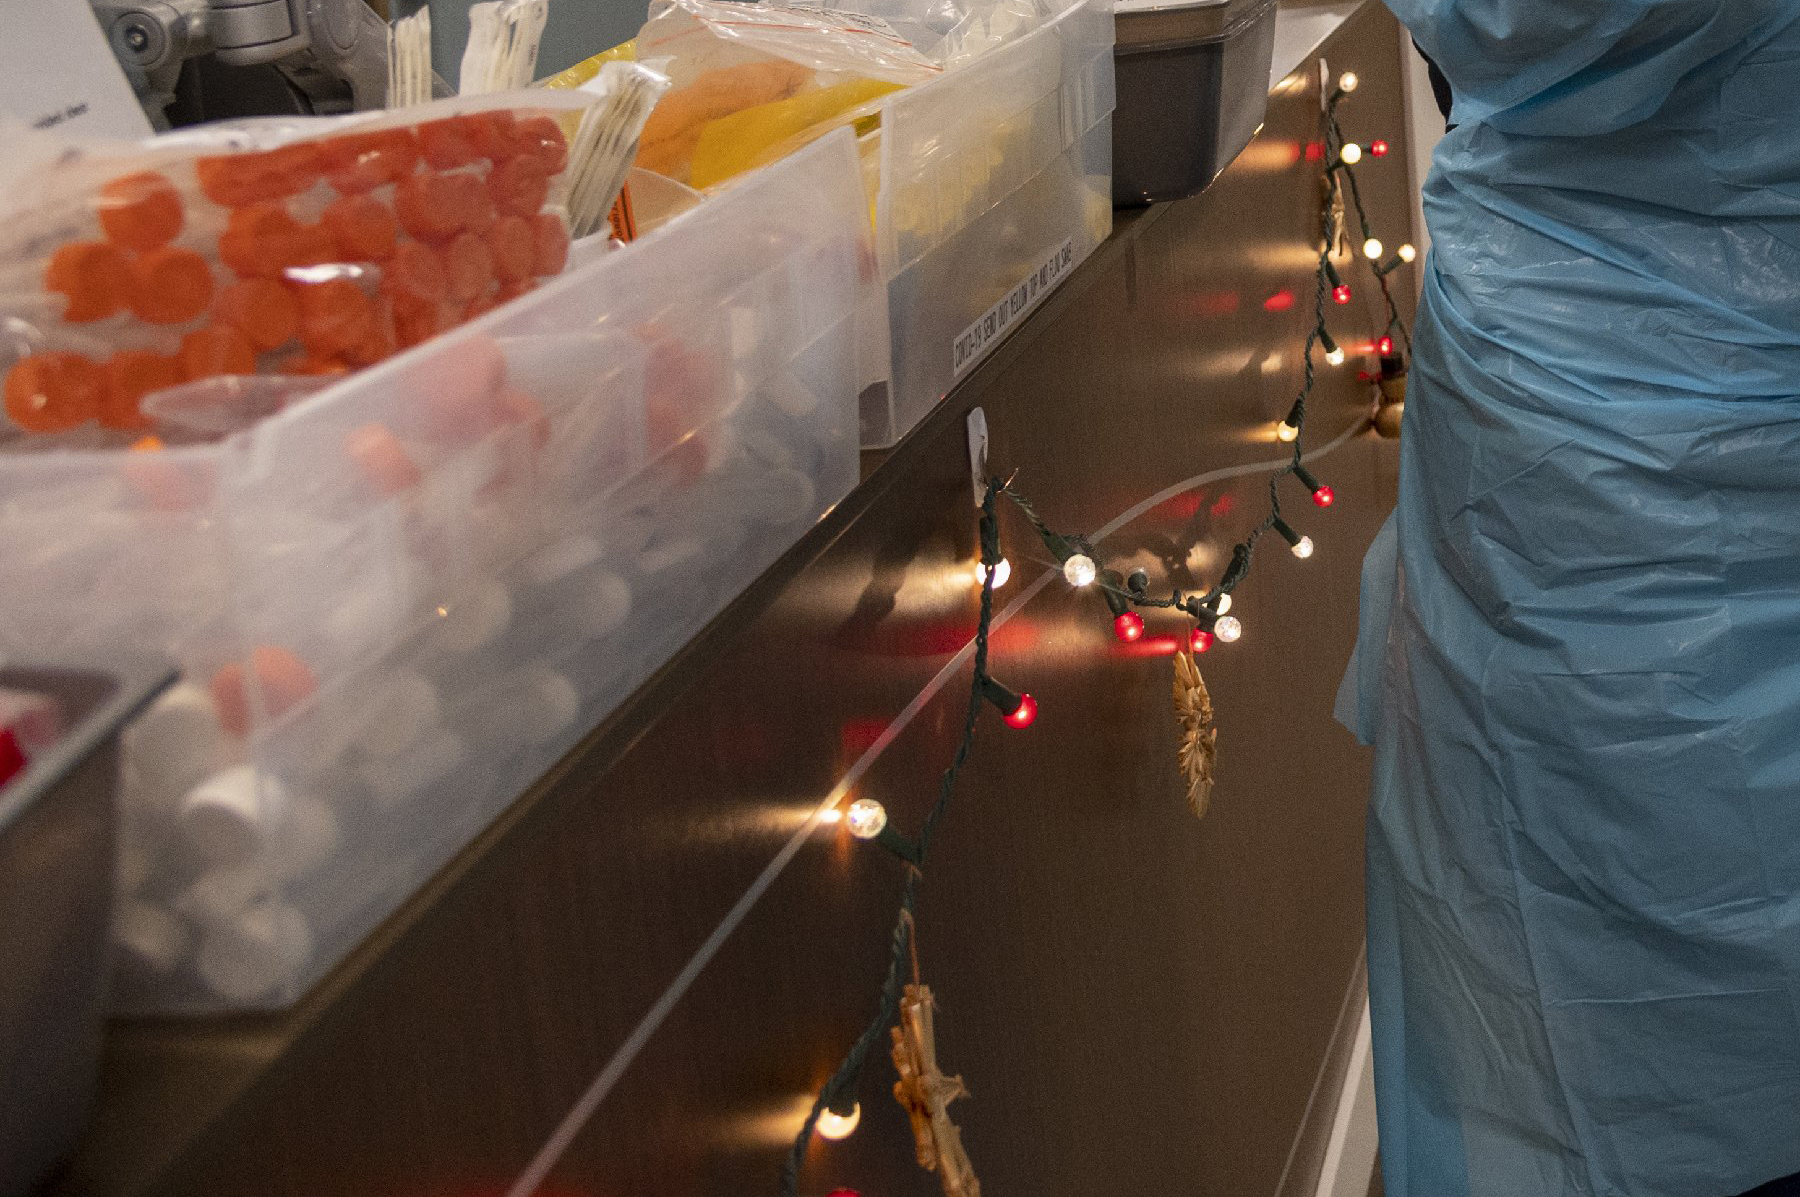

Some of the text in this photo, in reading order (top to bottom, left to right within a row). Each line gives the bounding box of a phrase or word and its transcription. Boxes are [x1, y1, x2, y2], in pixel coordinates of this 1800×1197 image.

[955, 323, 981, 369] COVID-19
[984, 311, 997, 343] SEND
[999, 300, 1009, 328] OUT
[1010, 282, 1028, 318] YELLOW
[1030, 273, 1038, 298] TOP
[1040, 264, 1048, 288] AND
